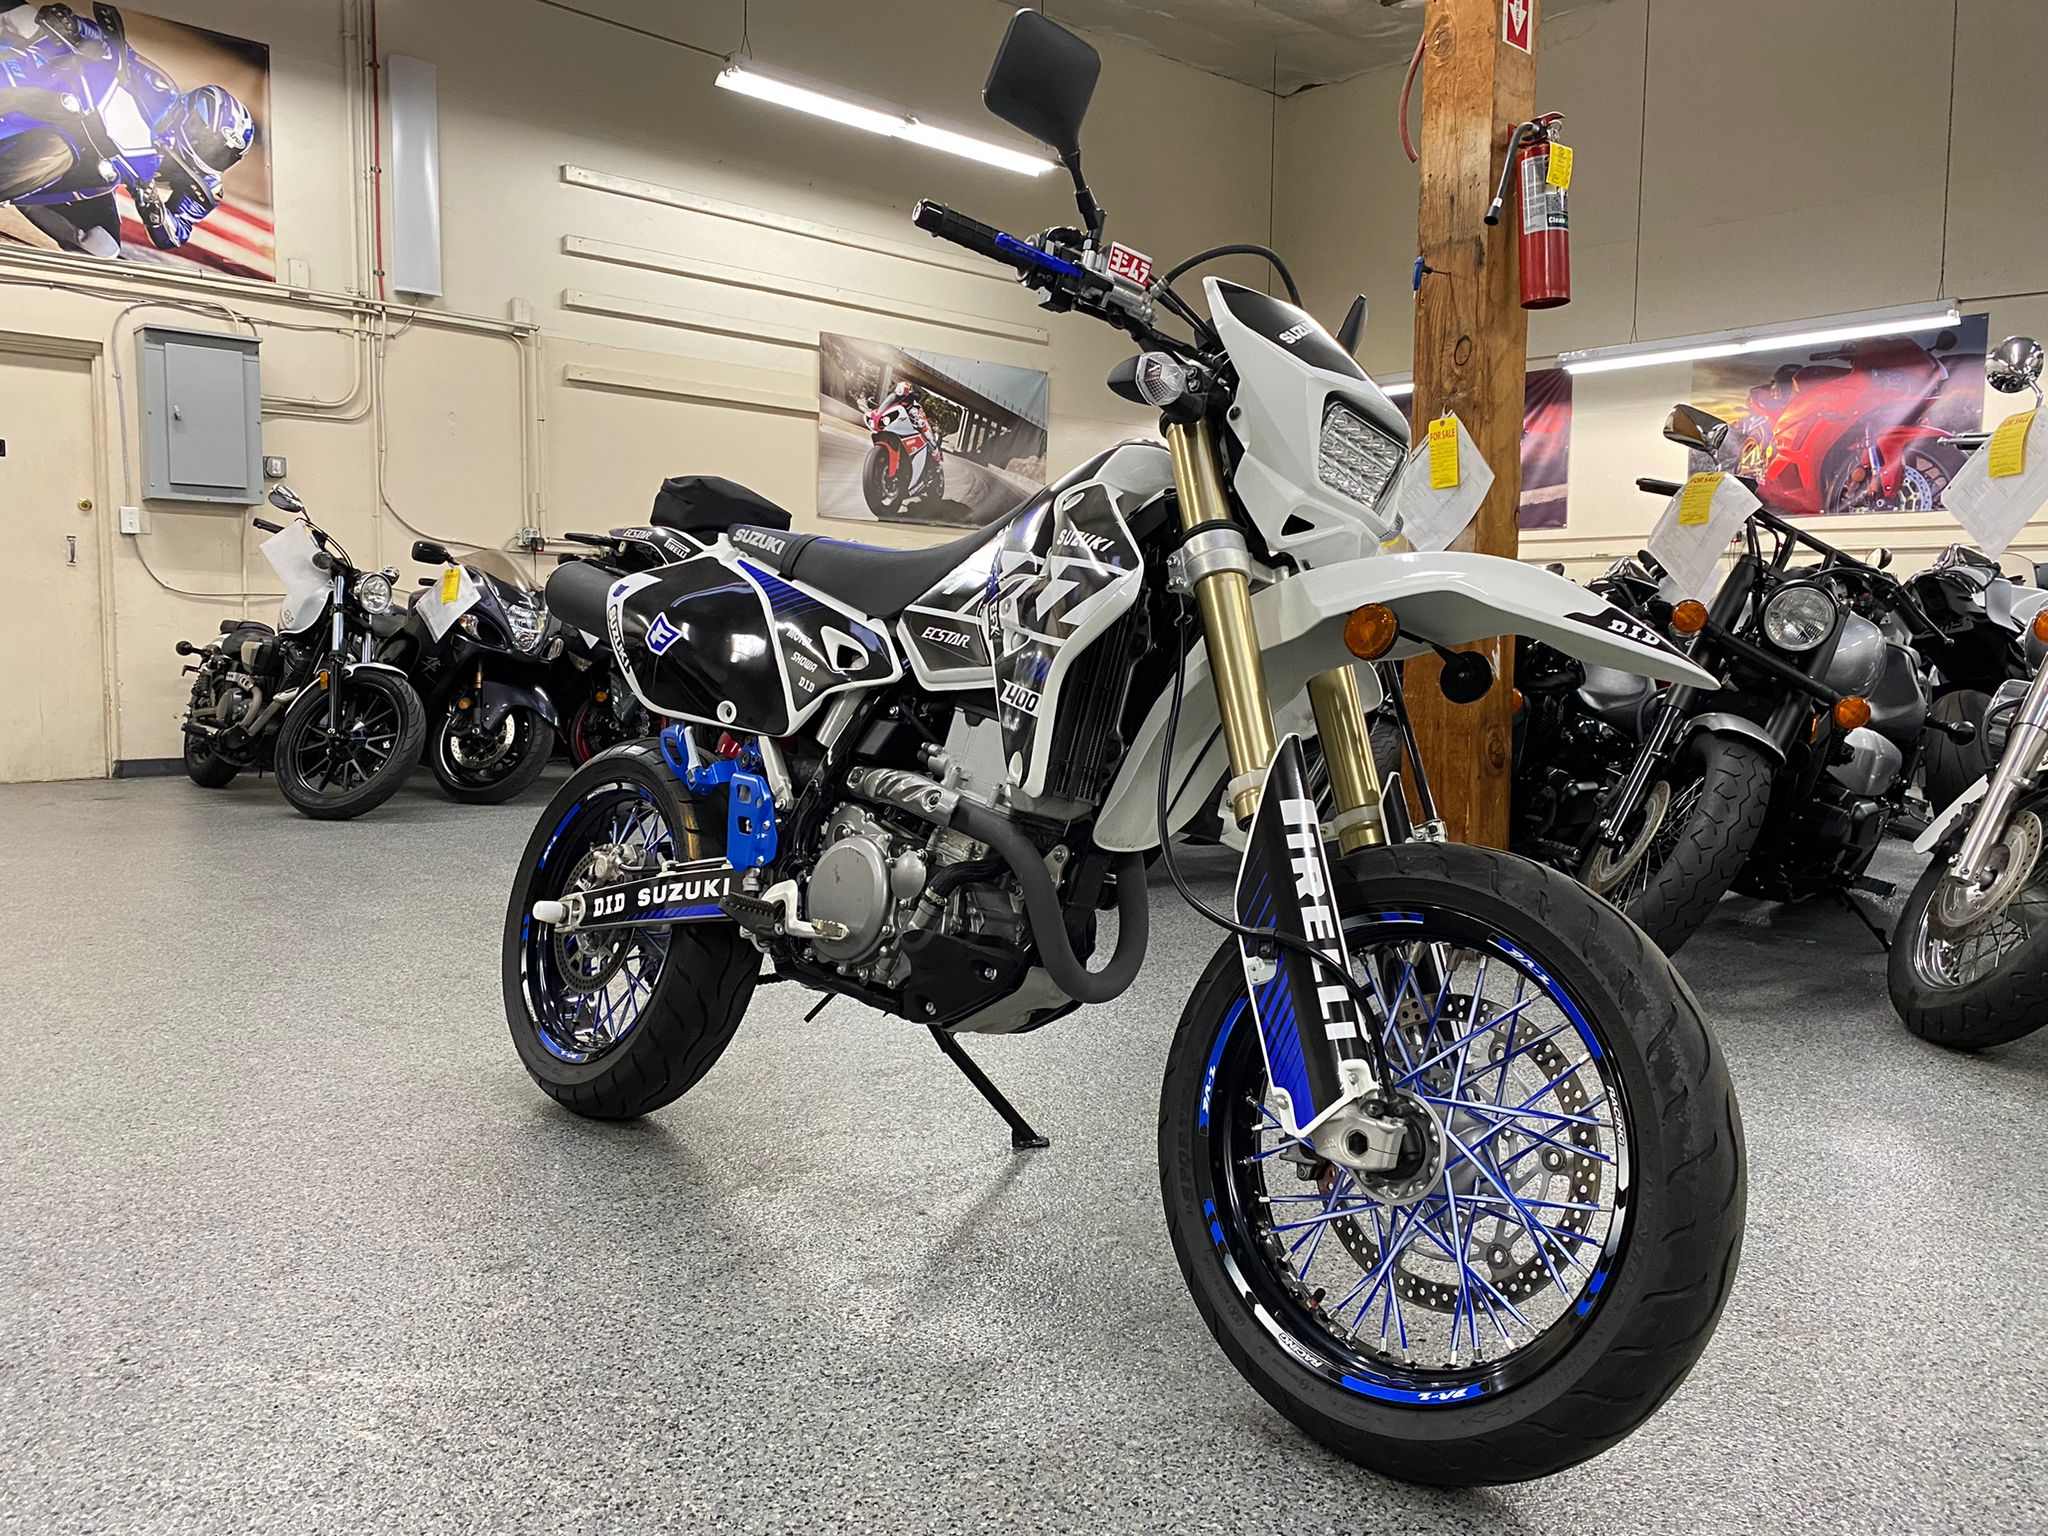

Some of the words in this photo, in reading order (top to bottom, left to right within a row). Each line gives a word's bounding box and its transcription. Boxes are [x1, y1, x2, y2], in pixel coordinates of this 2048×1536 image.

[1110, 248, 1150, 284] ヨシムラ
[1430, 432, 1441, 441] FOR
[1442, 428, 1455, 439] SALE
[664, 537, 690, 559] PIRELLI
[733, 528, 786, 555] SUZUKI
[1057, 529, 1115, 552] SUZUKI
[608, 605, 629, 668] SUZUKI
[921, 626, 971, 649] ECSTAR
[1607, 619, 1660, 645] D.I.D
[790, 651, 818, 673] SHOWA
[1006, 688, 1039, 711] 400
[637, 877, 731, 907] SUZUKI
[1606, 1085, 1624, 1145] RACING
[1279, 1333, 1323, 1367] RACING
